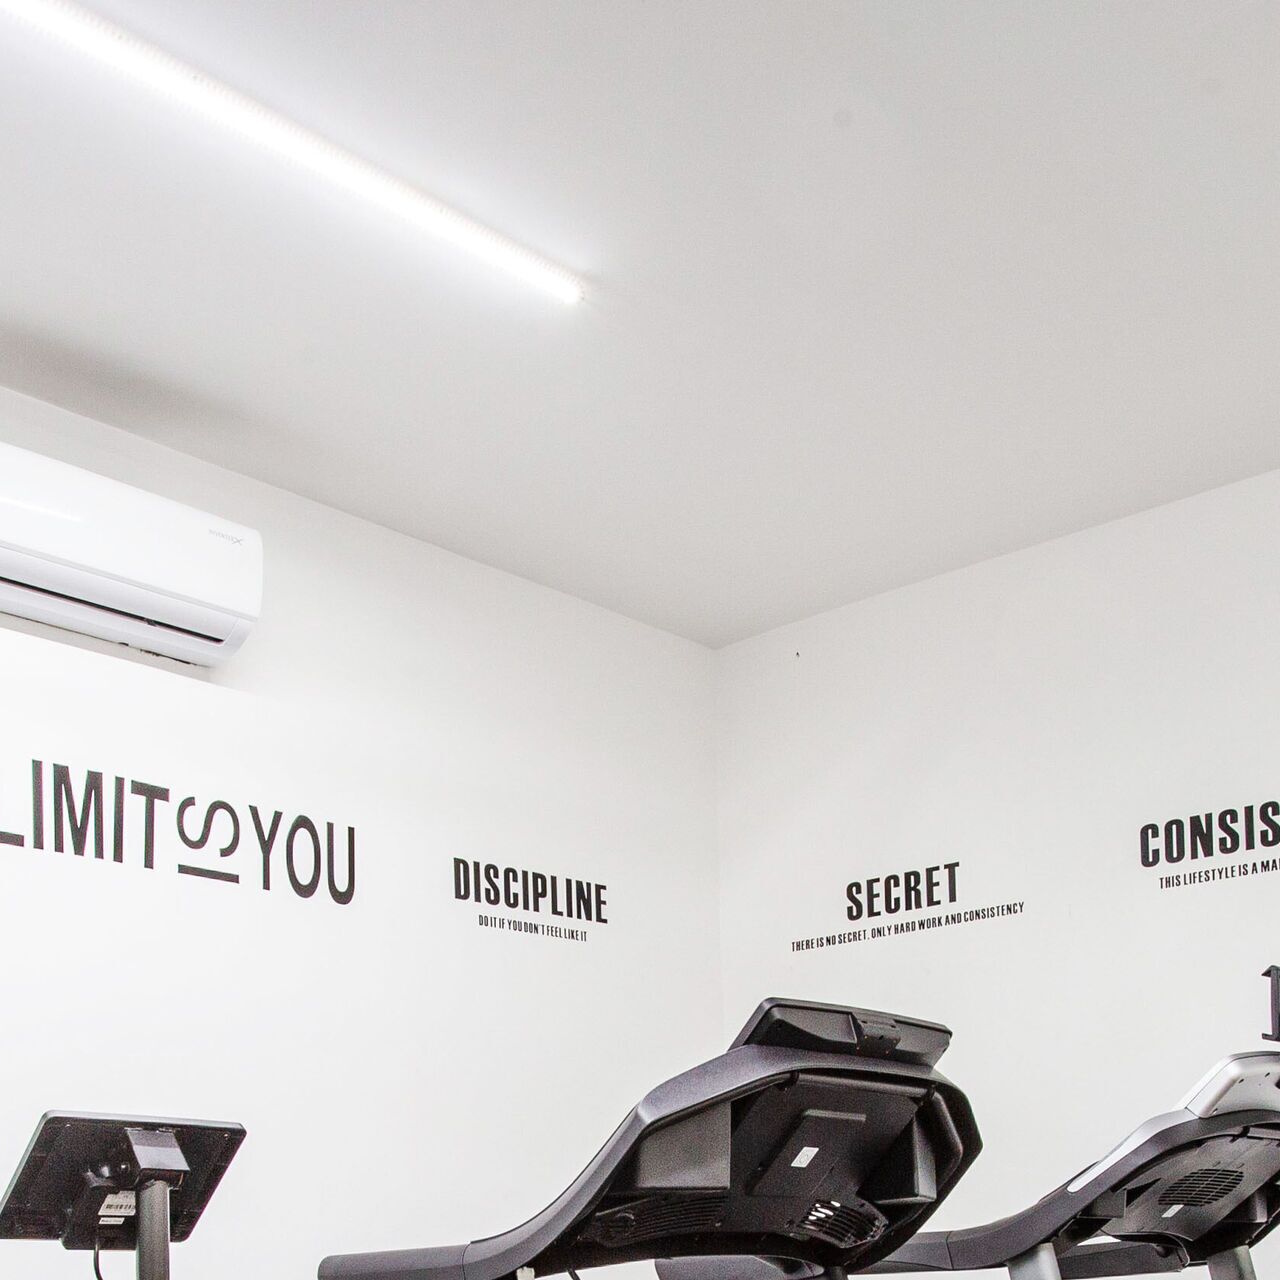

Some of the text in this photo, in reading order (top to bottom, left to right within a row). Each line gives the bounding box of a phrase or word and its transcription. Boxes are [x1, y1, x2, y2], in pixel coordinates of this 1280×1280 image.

[177, 797, 240, 884] IS
[249, 805, 355, 905] YOU
[1160, 875, 1181, 889] THIS
[1184, 866, 1235, 885] LIFESTYLE
[1239, 864, 1248, 876] IS
[1252, 862, 1258, 874] A
[454, 858, 608, 924] DISCIPLINE
[847, 862, 961, 921] SECRET
[479, 915, 488, 926] DO
[490, 917, 496, 928] IT
[499, 918, 505, 929] IF
[507, 919, 522, 931] YOU
[547, 925, 563, 938] FEEL
[564, 928, 579, 941] LIKE
[581, 931, 587, 942] IT
[792, 939, 814, 952] THERE
[817, 937, 824, 948] IS
[826, 935, 836, 946] NO
[871, 925, 892, 939] ONLY
[894, 921, 916, 934] HARD
[918, 916, 942, 930] WORK
[945, 913, 962, 926] AND
[964, 902, 1024, 922] CONSISTENCY
